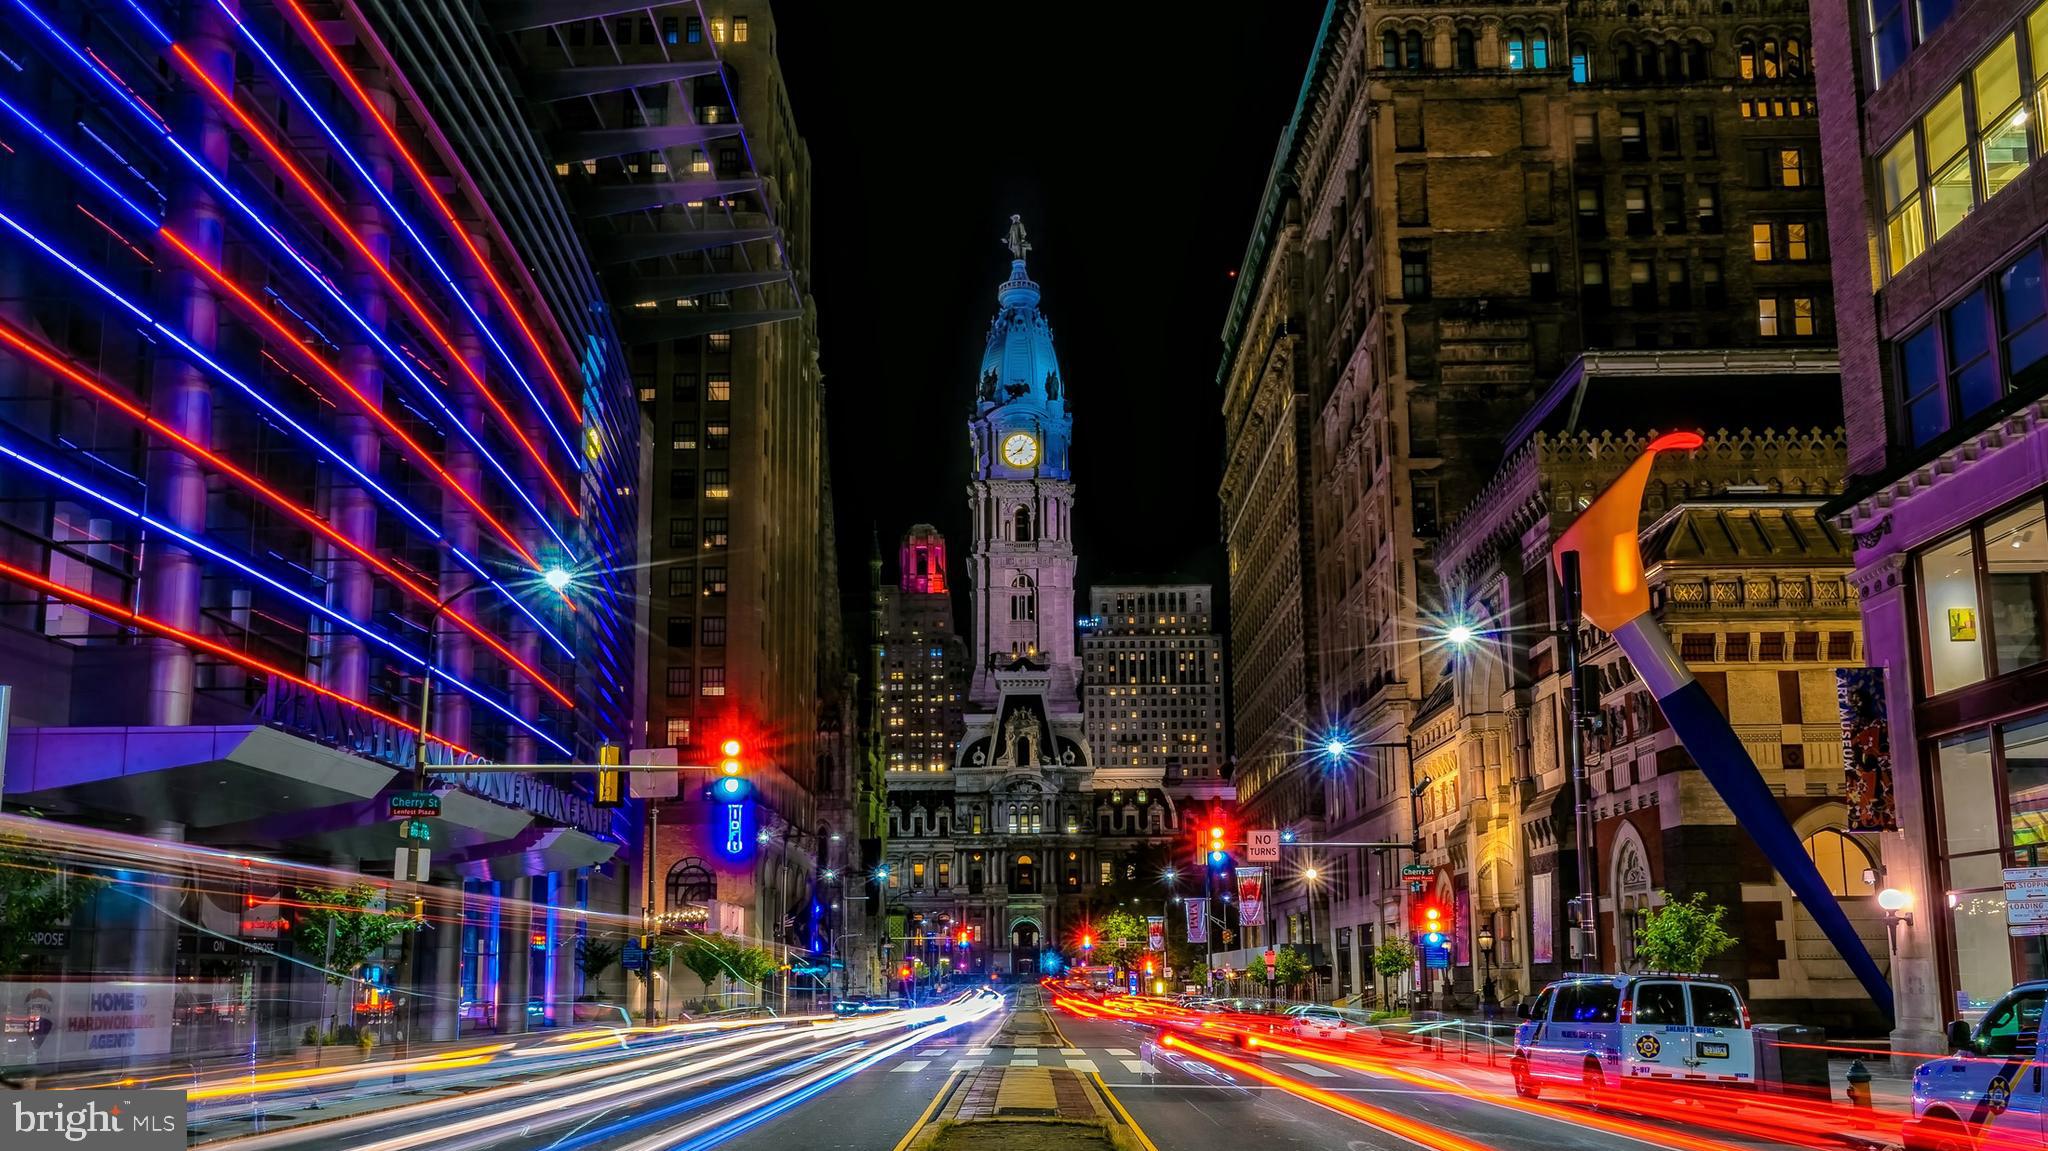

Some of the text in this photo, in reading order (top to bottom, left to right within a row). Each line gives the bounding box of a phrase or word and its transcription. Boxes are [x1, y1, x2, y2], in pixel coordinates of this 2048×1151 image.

[1836, 676, 1853, 771] ART MUSEUM
[392, 797, 438, 809] Cherry St
[1255, 834, 1272, 845] NO
[1249, 847, 1277, 856] TURNS
[1427, 868, 1434, 876] St
[2005, 882, 2016, 890] NO
[2010, 902, 2044, 910] LOADING
[213, 940, 225, 952] ON
[91, 992, 135, 1012] HOME
[1696, 1026, 1716, 1034] OFFICE
[88, 1032, 136, 1050] AGENTS
[1607, 1055, 1619, 1065] 911
